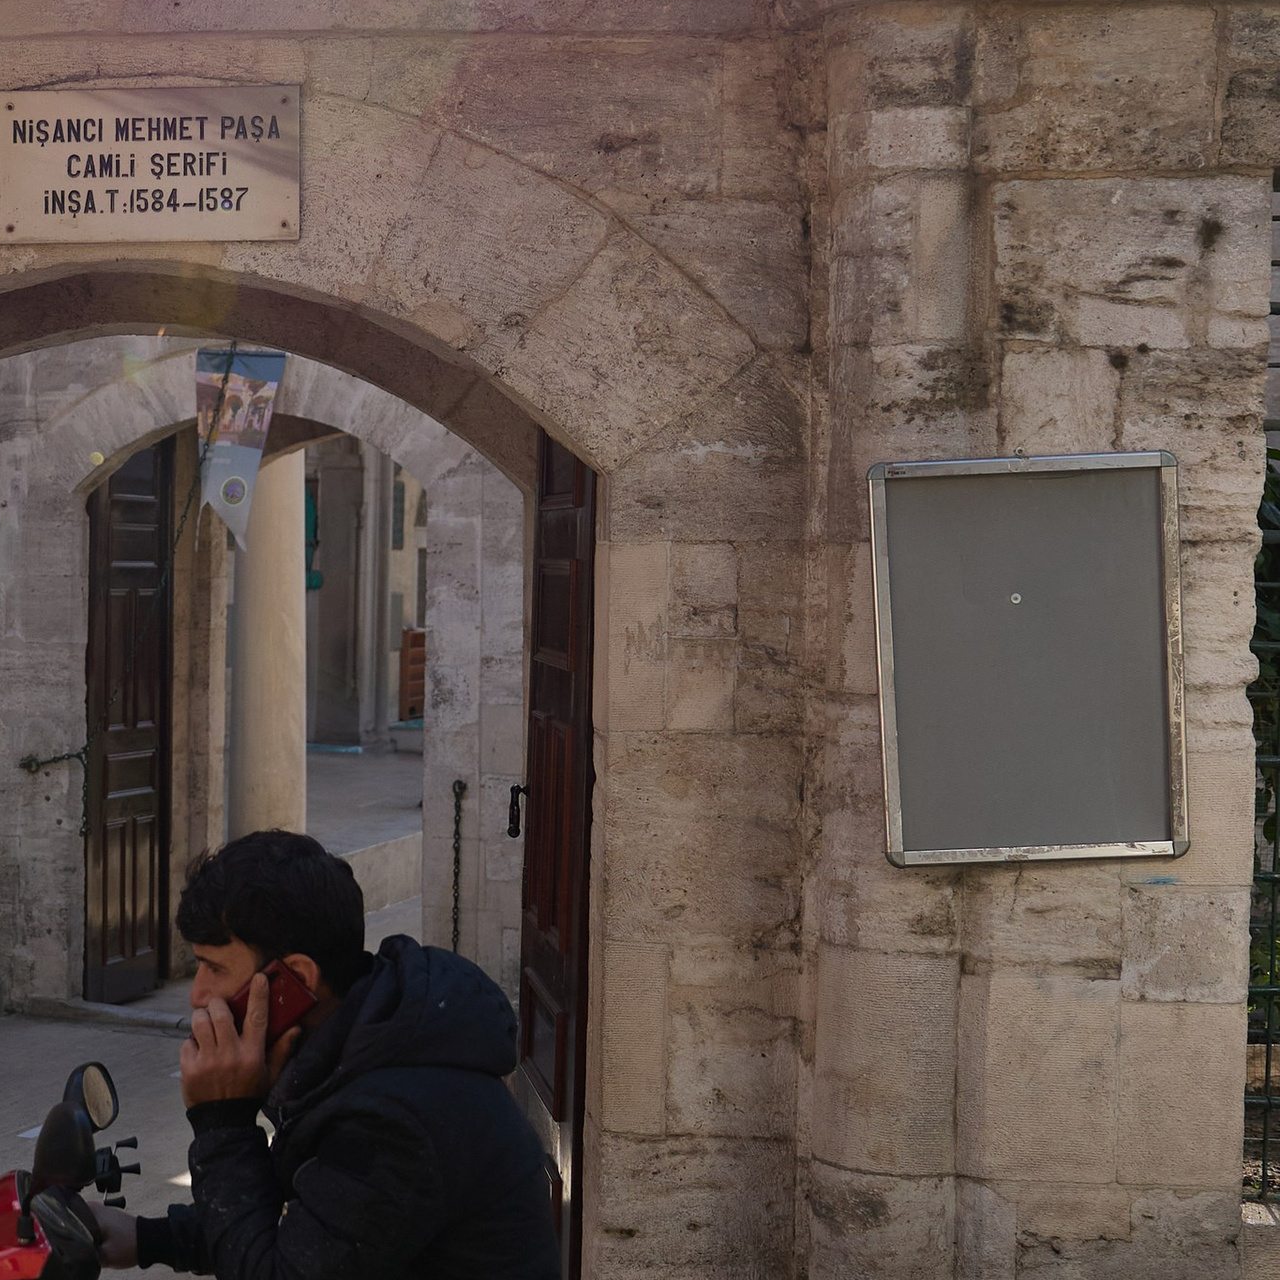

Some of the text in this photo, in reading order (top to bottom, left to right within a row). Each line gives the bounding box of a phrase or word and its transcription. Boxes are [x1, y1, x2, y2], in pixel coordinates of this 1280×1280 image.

[12, 115, 281, 147] NİŞANCI MEHMET PAŞA
[149, 151, 228, 180] ŞERİFİ
